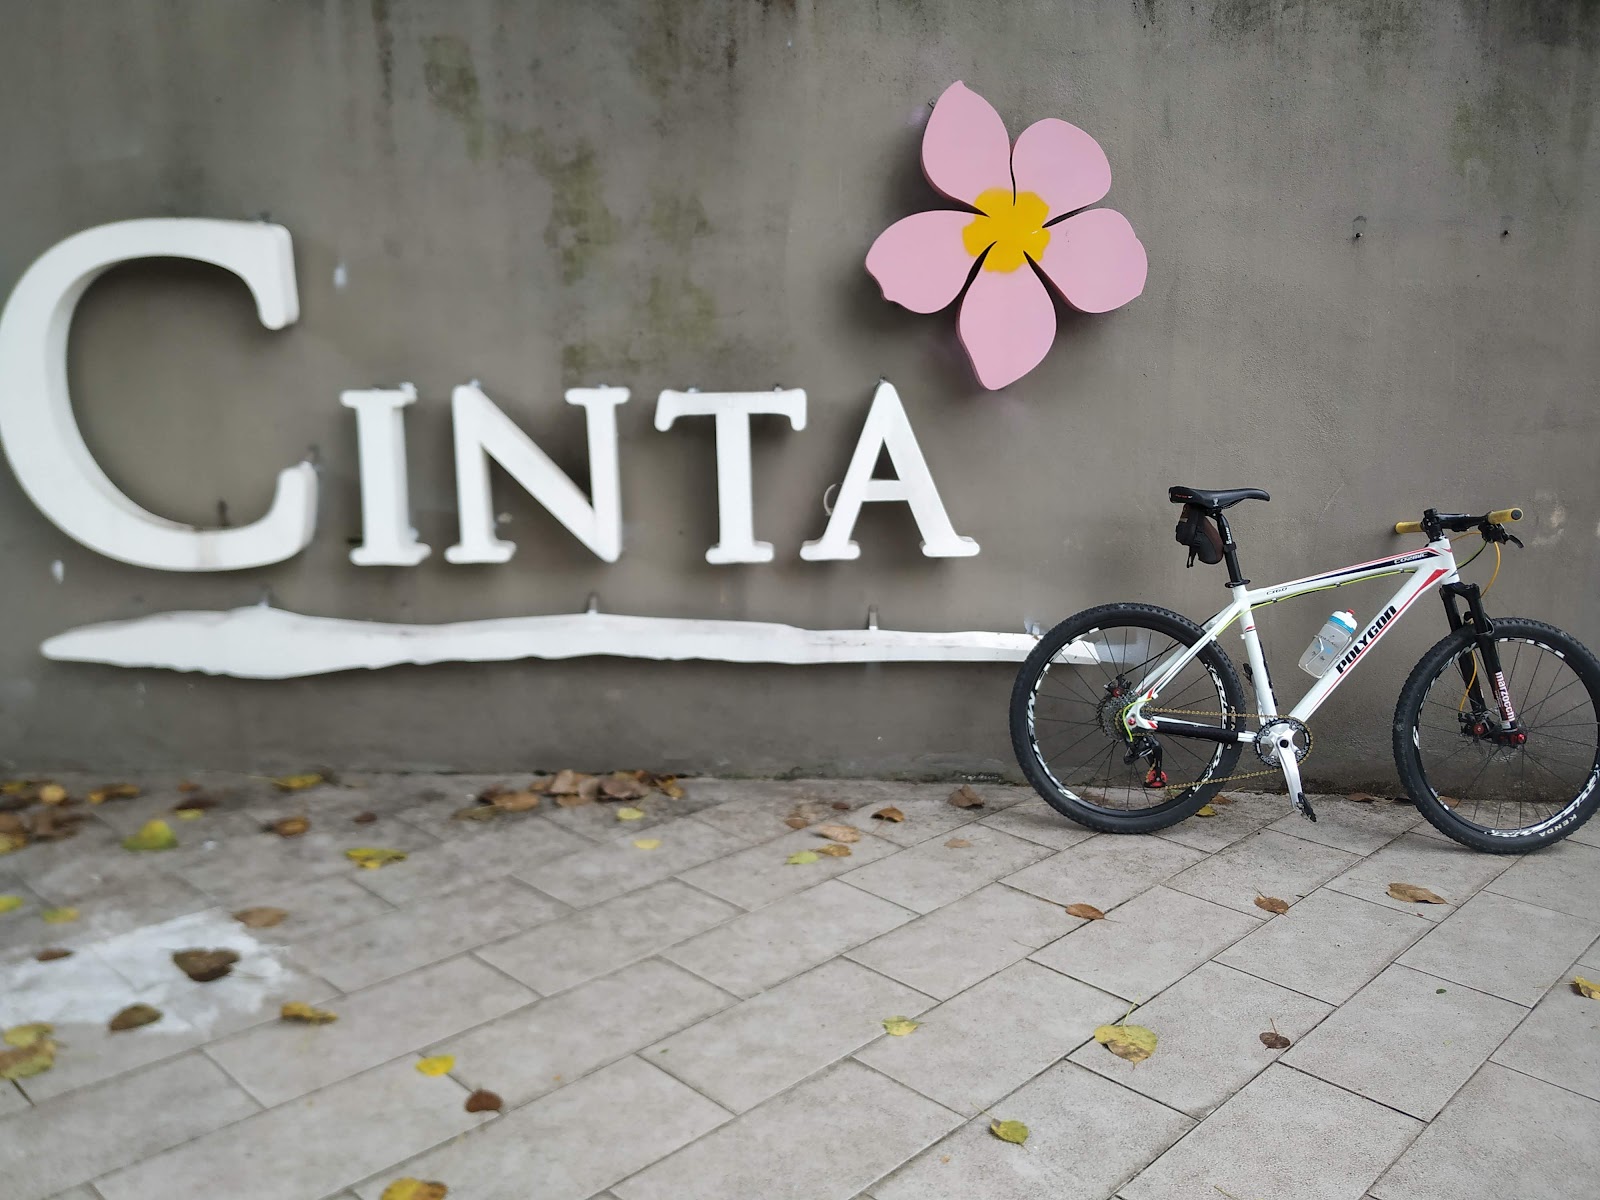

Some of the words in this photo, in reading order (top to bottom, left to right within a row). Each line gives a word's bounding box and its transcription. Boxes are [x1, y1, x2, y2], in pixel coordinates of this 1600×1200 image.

[0, 217, 980, 571] CINTA
[1336, 605, 1397, 674] POLYGON
[1226, 705, 1236, 750] KENA
[1539, 814, 1577, 837] KENDA
